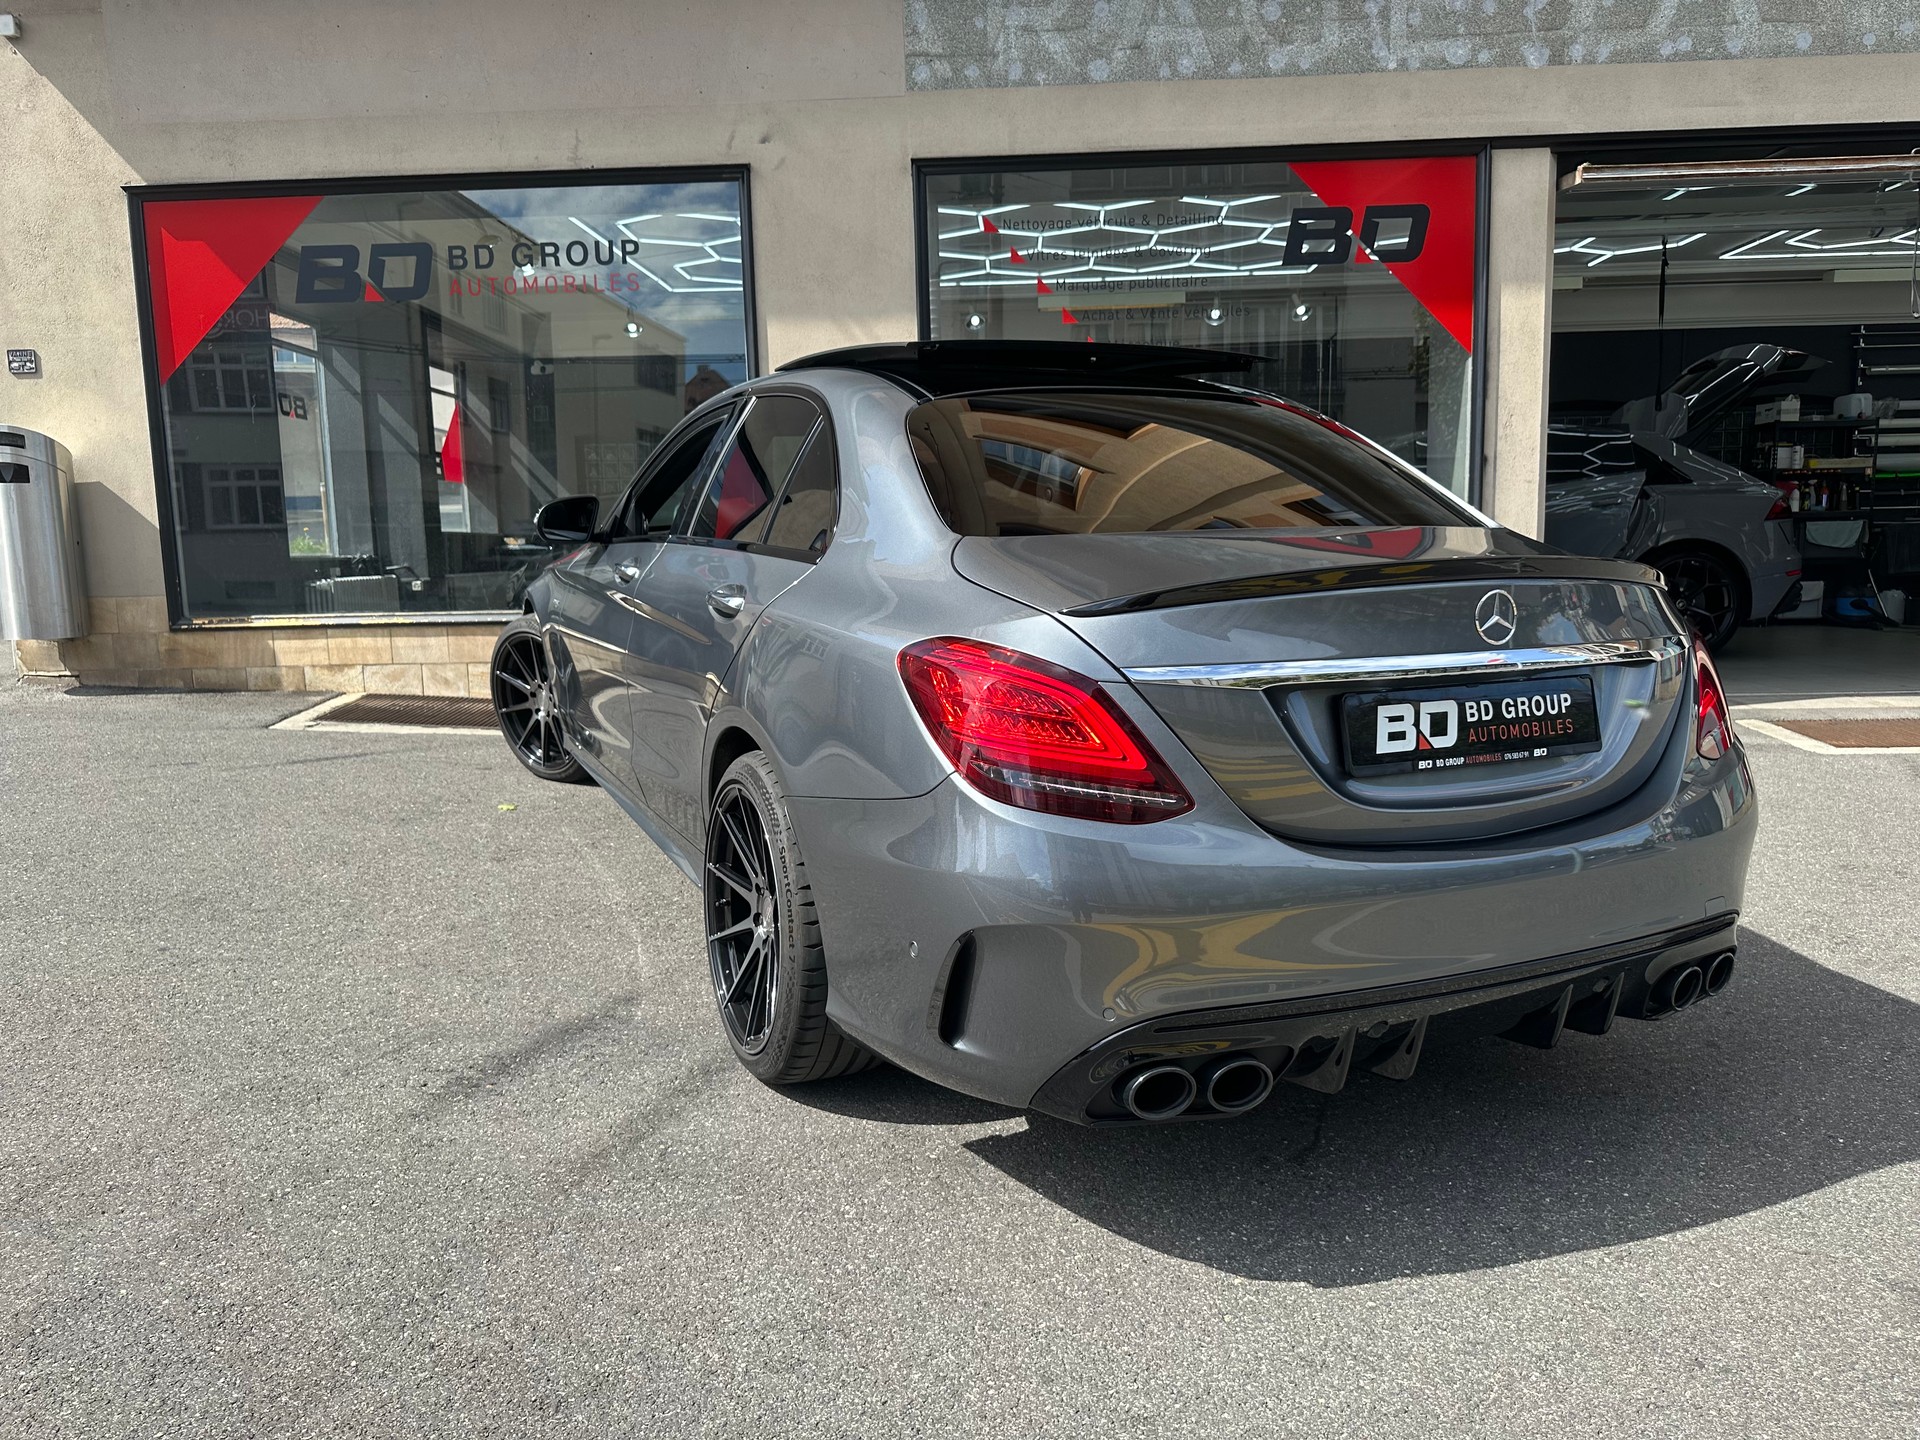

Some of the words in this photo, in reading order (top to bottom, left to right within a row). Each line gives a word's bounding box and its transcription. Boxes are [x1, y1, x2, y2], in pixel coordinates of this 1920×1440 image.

[1002, 217, 1071, 231] Nettoyage
[1077, 215, 1136, 228] véhicule
[1141, 215, 1150, 226] &
[1157, 213, 1224, 226] Detailling
[1282, 204, 1431, 266] BD
[448, 244, 495, 270] BD
[512, 240, 640, 267] GROUP
[1026, 249, 1067, 262] Vitres
[1074, 246, 1128, 259] teintées
[1134, 247, 1143, 258] &
[1150, 244, 1211, 258] Covering
[295, 241, 433, 303] BD
[1056, 279, 1123, 292] Marquage
[1129, 276, 1208, 290] publicitaire
[449, 273, 640, 297] AUTOMOBILES
[1082, 308, 1120, 321] Achat
[1125, 309, 1135, 320] &
[1141, 308, 1179, 320] Vente
[1185, 304, 1250, 318] véhules
[1464, 700, 1494, 722] BD
[1501, 693, 1572, 719] GROUP
[1376, 700, 1458, 754] BD
[1468, 719, 1574, 743] AUTOMOBILES
[1436, 759, 1444, 767] BD
[1445, 757, 1464, 766] GROUP
[1465, 753, 1502, 764] AUTOMOBILES
[778, 846, 795, 949] SportContact
